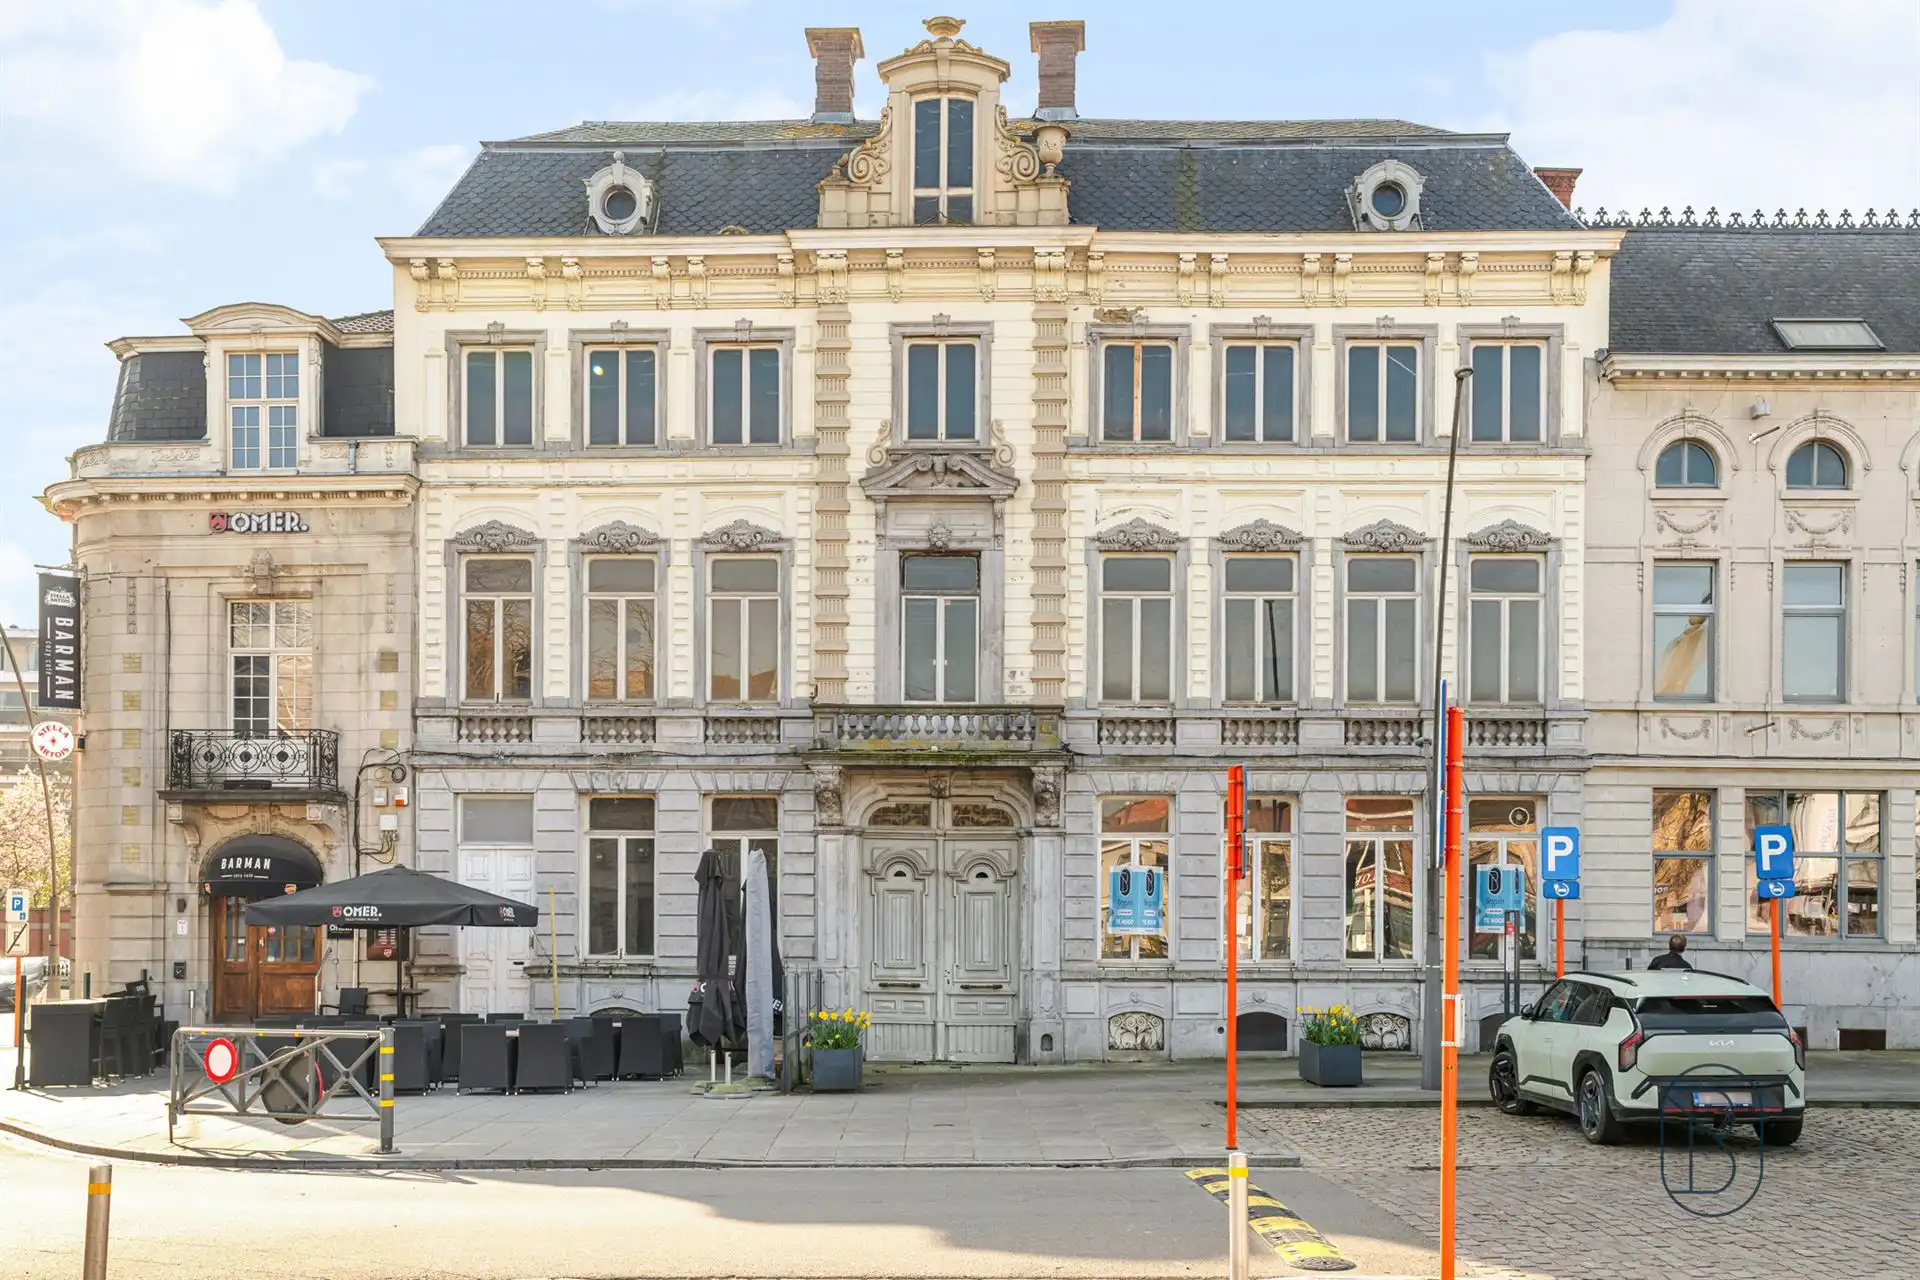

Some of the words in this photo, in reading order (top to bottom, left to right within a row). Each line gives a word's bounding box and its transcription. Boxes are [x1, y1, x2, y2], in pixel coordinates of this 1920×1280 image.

[55, 616, 74, 700] BARMAN
[38, 724, 69, 738] STELLA
[39, 744, 70, 759] ARTOIS
[221, 857, 271, 870] BARMAN
[1547, 835, 1574, 872] P
[1760, 833, 1788, 872] P
